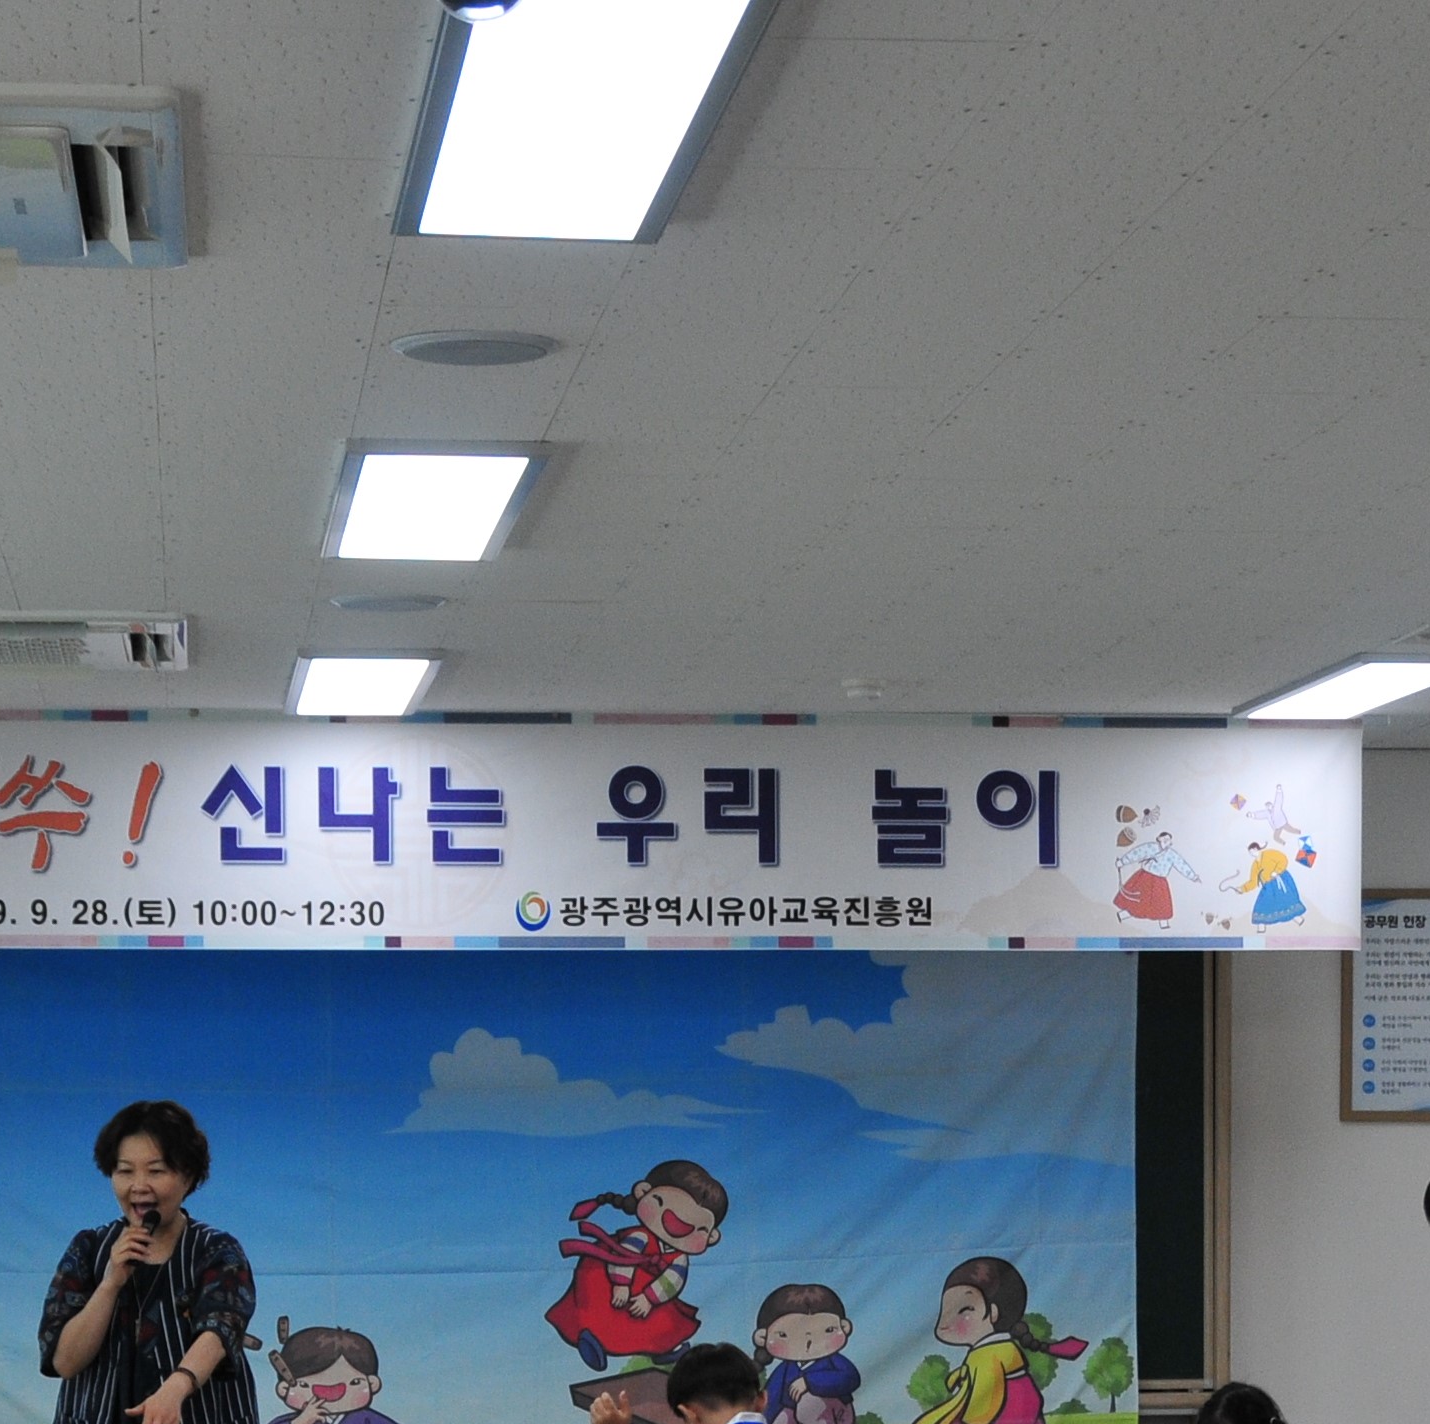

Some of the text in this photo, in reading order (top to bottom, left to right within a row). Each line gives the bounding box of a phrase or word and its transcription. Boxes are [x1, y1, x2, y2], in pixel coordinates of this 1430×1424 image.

[200, 764, 507, 865] 신나는
[595, 764, 780, 866] 우리
[871, 768, 1059, 868] 놀이
[30, 898, 58, 926] 9.
[71, 896, 177, 928] 28.(토)
[192, 899, 386, 927] 10:00~12:30
[559, 895, 933, 928] 광주광역시유아교육진흥원
[1363, 914, 1427, 929] 공무원 헌장
